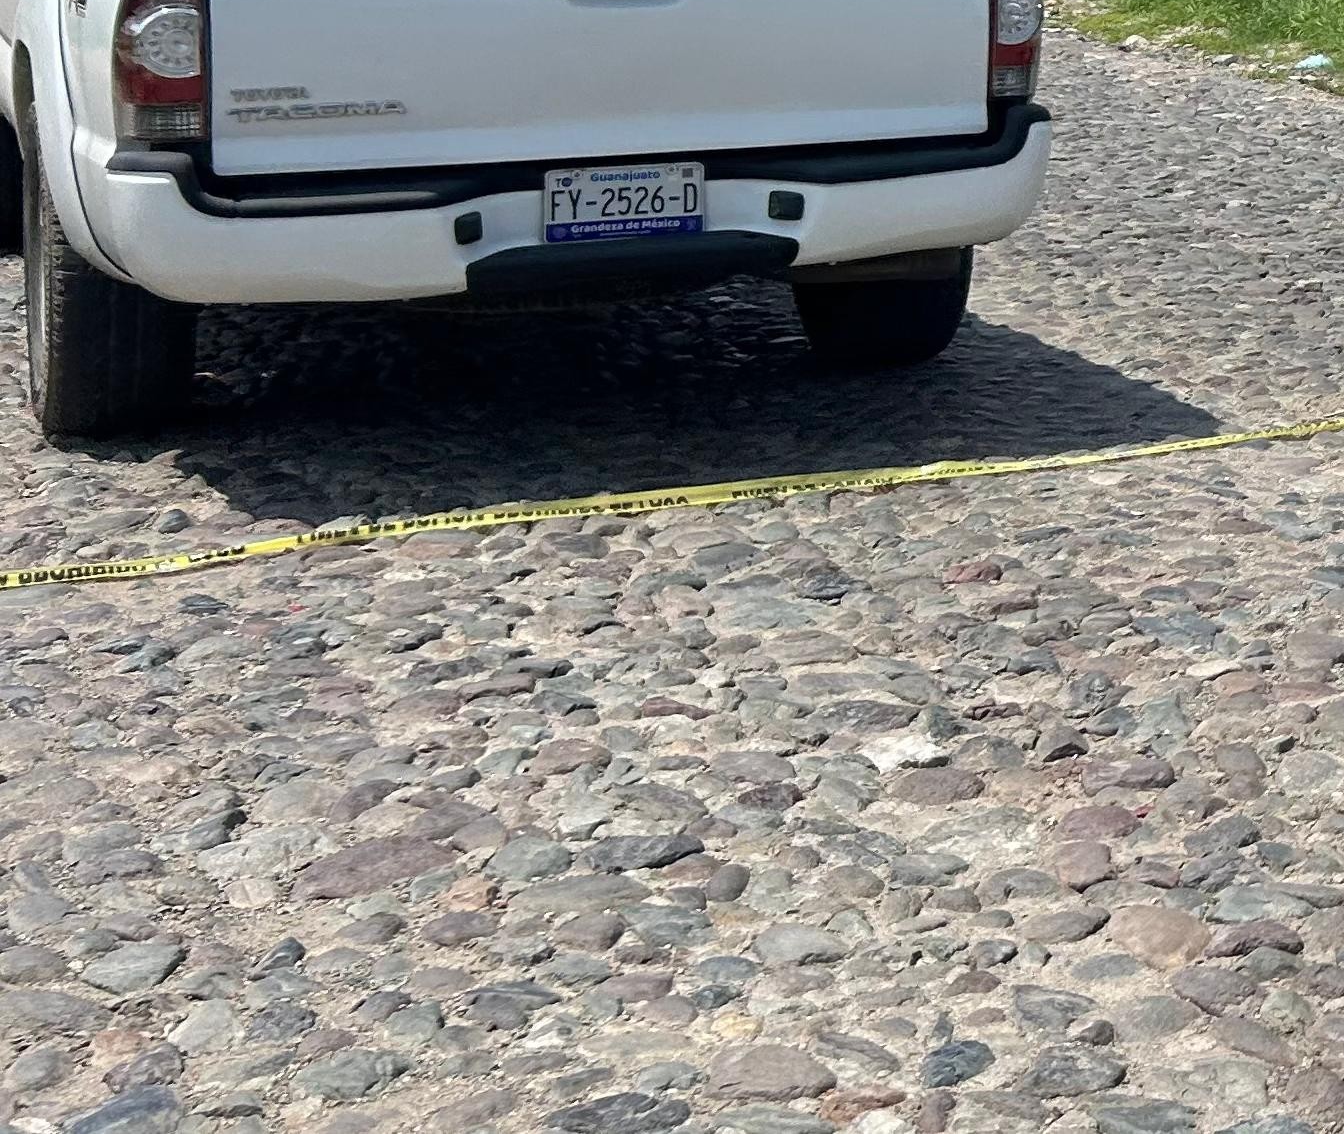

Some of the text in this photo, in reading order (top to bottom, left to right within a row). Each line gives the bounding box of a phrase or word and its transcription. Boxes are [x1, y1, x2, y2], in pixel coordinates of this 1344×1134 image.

[590, 170, 661, 183] Guanajuato
[551, 182, 698, 222] FY-2526-D
[570, 220, 624, 234] Grandeza
[625, 219, 639, 230] de
[641, 217, 681, 229] México
